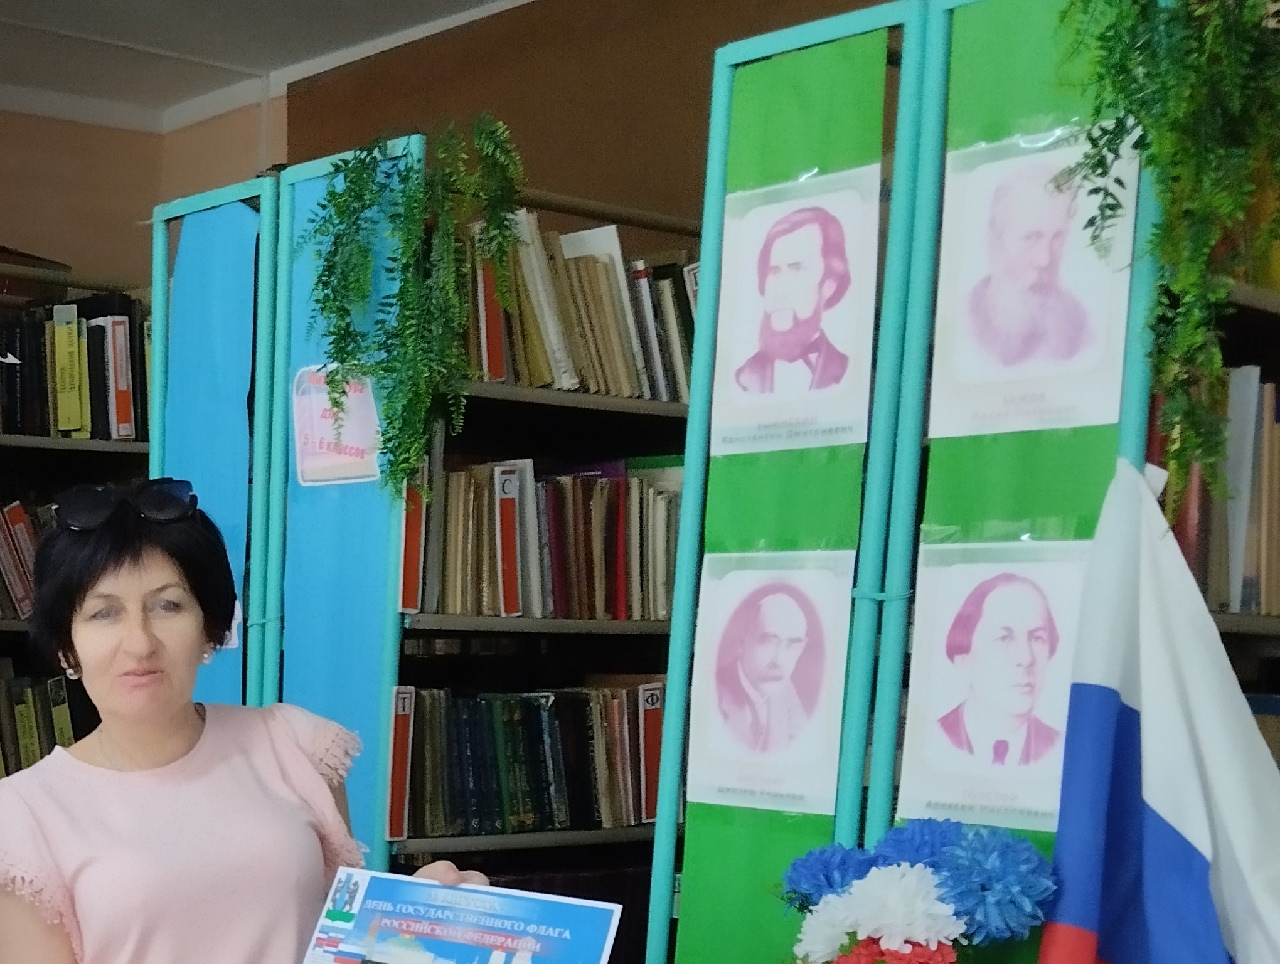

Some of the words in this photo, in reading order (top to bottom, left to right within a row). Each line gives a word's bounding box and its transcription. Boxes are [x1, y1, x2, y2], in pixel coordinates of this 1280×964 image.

[363, 898, 395, 913] ДЕНЬ
[395, 904, 524, 932] ГОСУДАРСТВЕННОГО
[525, 923, 572, 940] ФЛАГА
[380, 917, 461, 939] РОССИЙСКОЙ
[461, 930, 543, 954] ФЕДЕРАЦИИ
